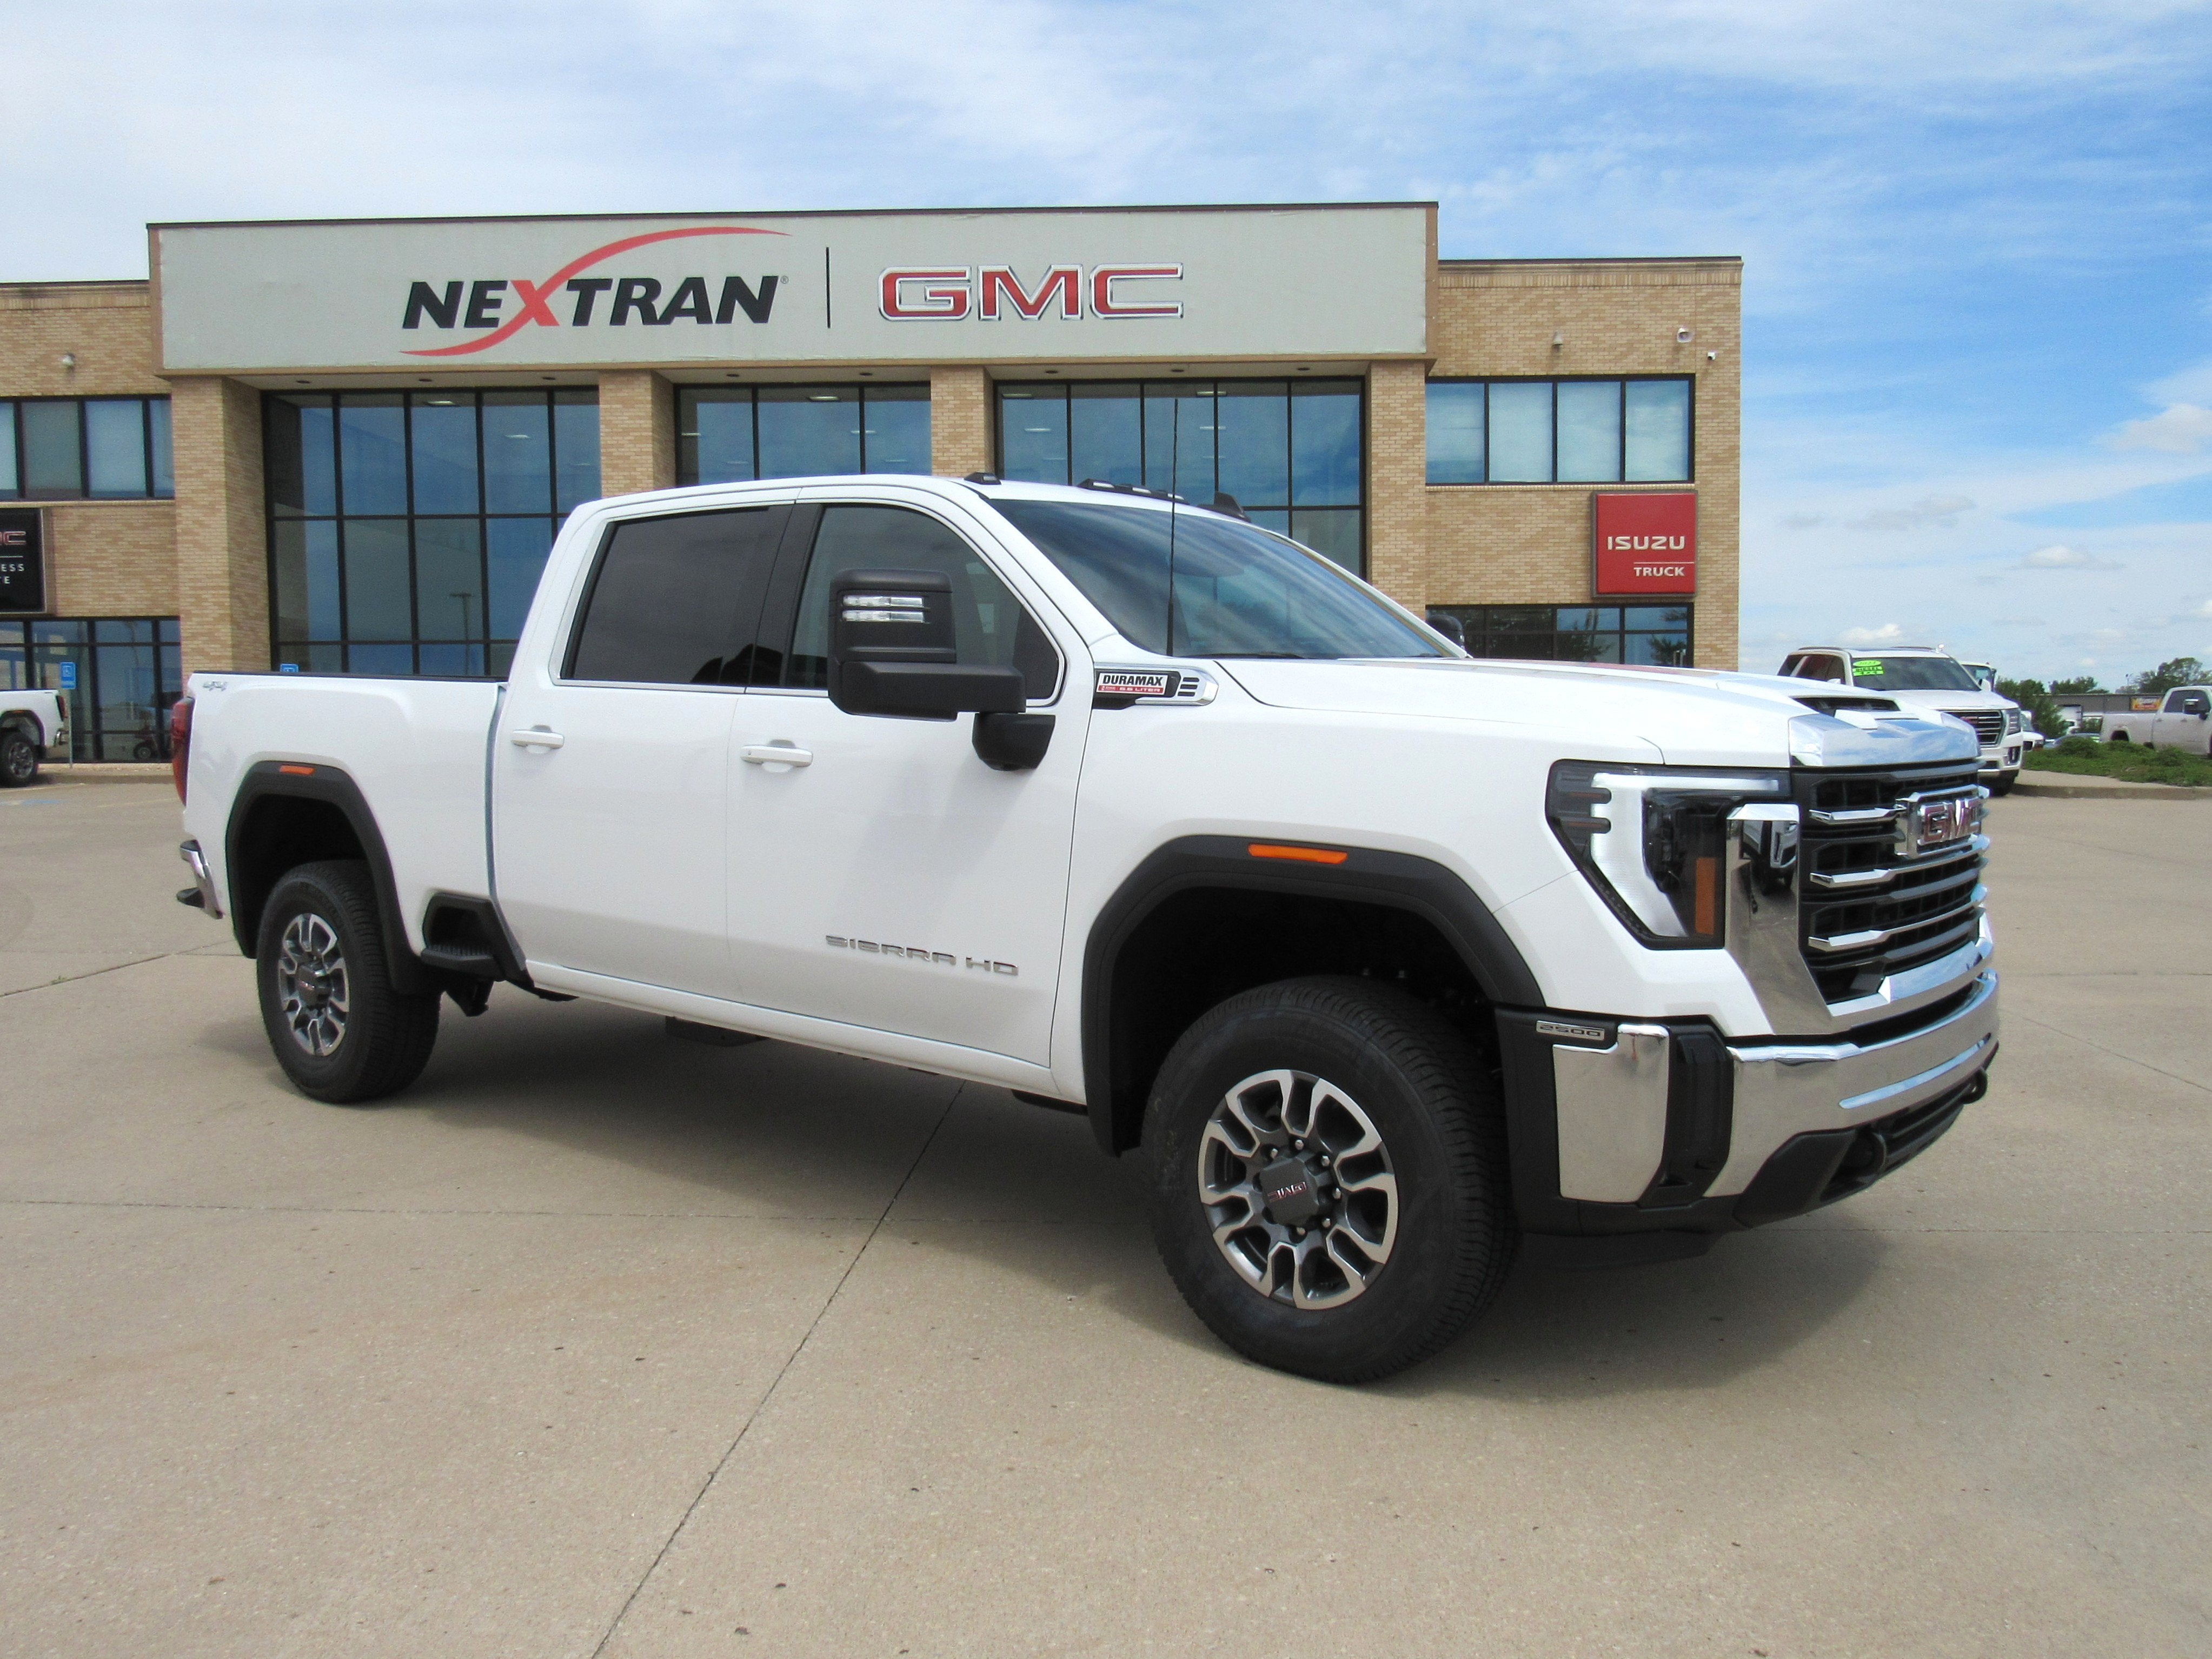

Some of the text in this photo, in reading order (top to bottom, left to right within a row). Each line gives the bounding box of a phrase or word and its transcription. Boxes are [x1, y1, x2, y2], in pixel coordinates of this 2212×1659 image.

[402, 275, 779, 329] NEXTRAN
[878, 262, 1184, 321] GMC
[1606, 535, 1685, 550] ISUZU
[1633, 567, 1685, 577] TRUCK
[1102, 675, 1163, 686] DURAMAX
[1917, 796, 1982, 845] GMC
[825, 935, 1019, 976] SIERRA HD
[1539, 1024, 1601, 1037] 2500
